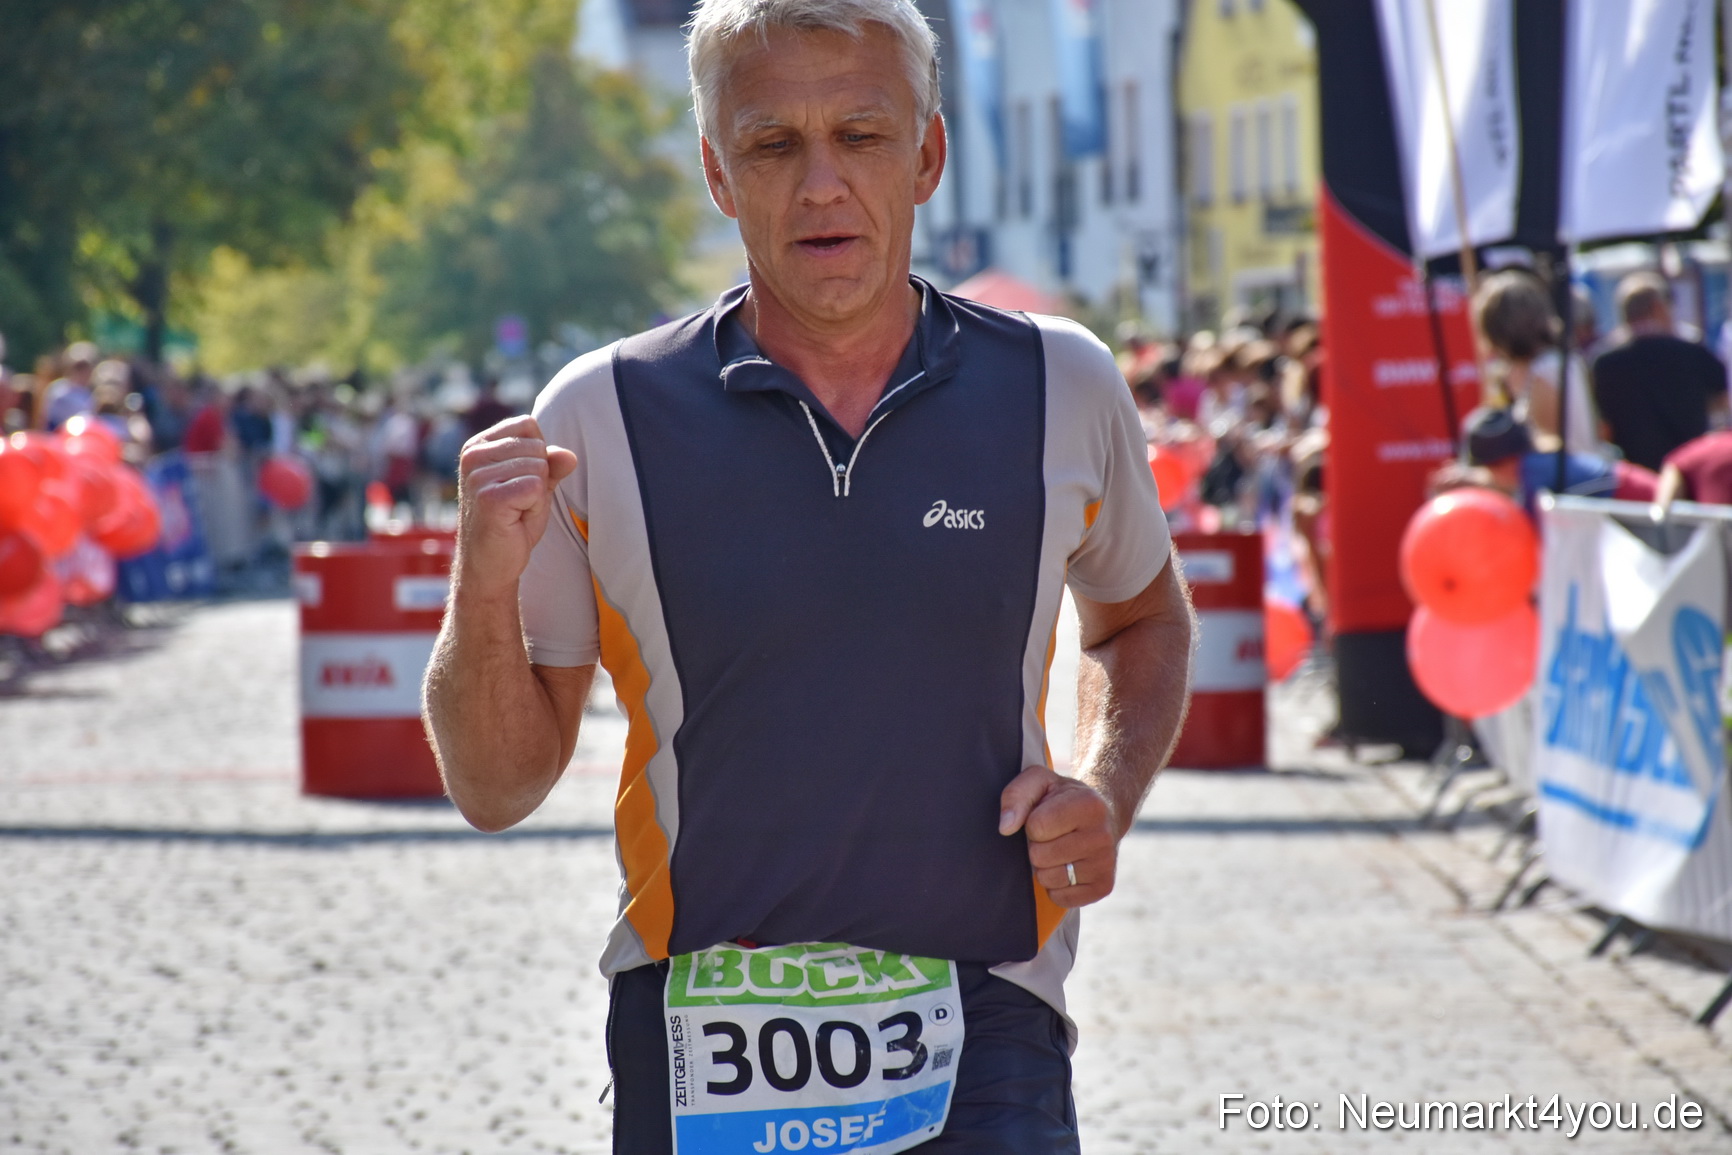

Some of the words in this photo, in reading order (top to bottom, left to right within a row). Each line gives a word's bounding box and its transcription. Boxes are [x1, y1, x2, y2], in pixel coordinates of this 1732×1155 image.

[690, 948, 922, 994] BOCK
[935, 1008, 947, 1020] D
[702, 1011, 928, 1096] 3003
[753, 1110, 887, 1154] JOSEF
